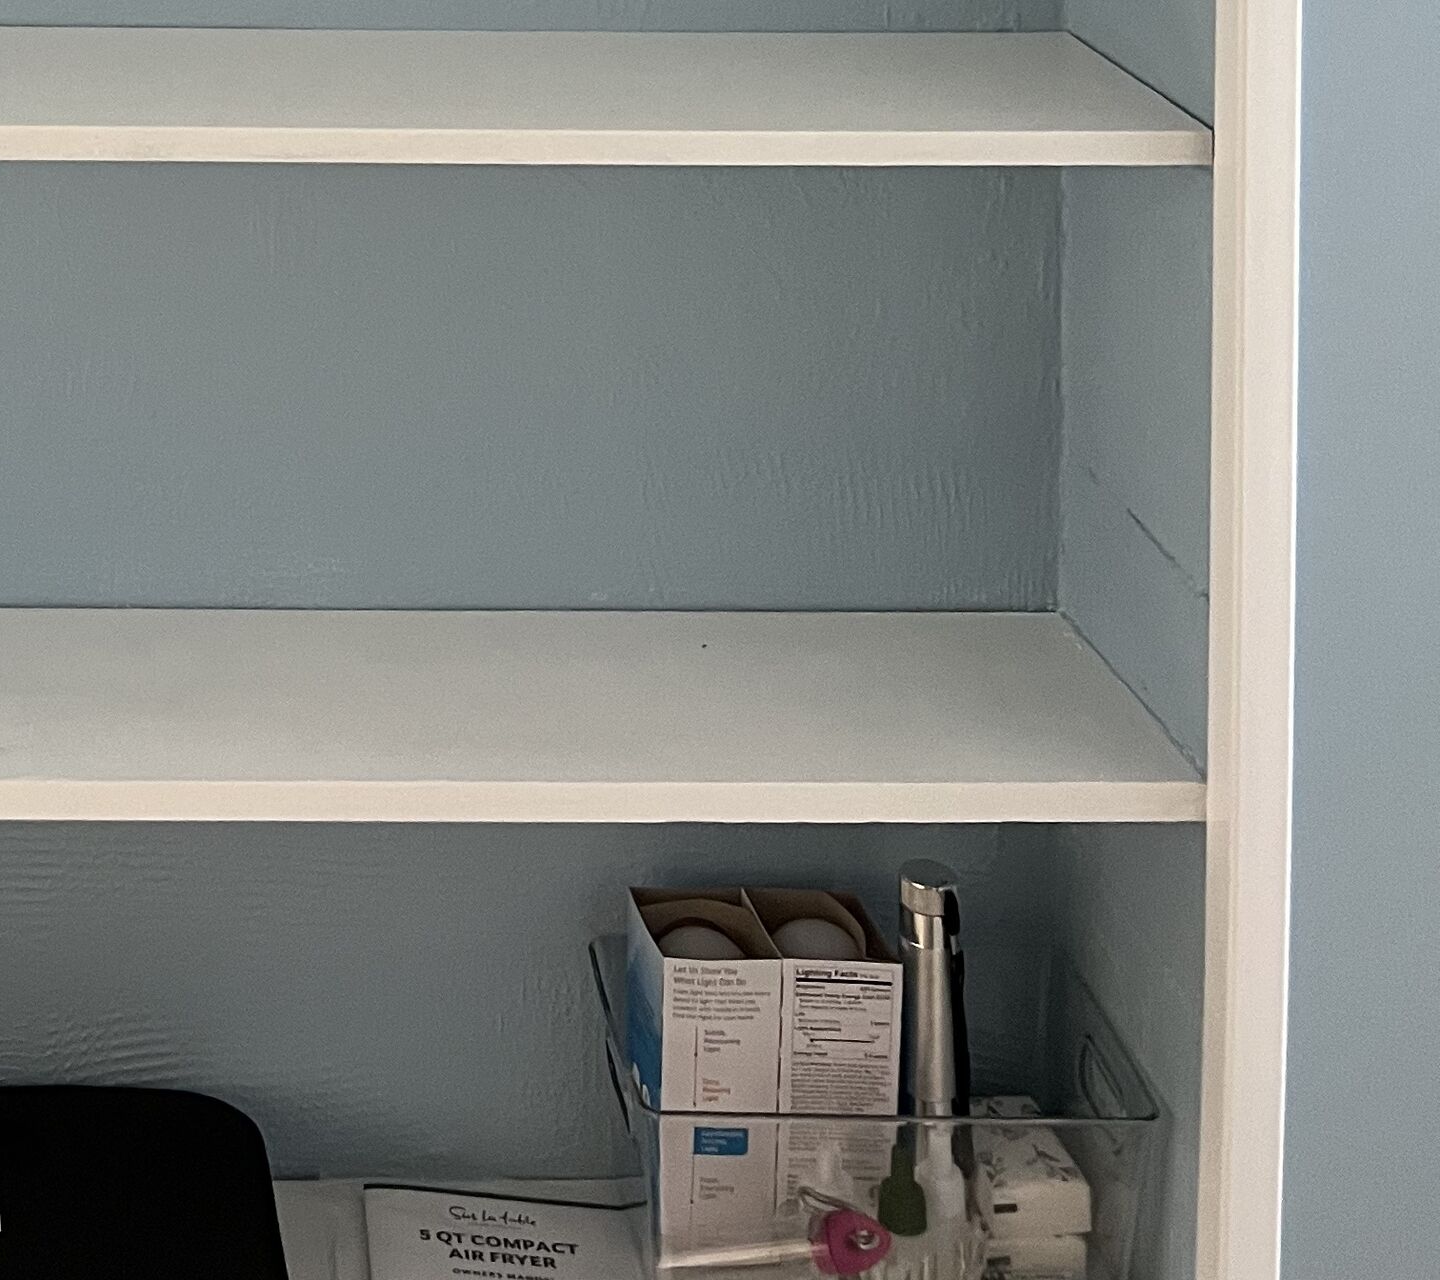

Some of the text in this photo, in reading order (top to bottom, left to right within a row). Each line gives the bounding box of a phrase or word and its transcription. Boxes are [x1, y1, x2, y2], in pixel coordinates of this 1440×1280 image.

[796, 968, 832, 978] Lighting
[419, 1229, 579, 1255] 5 QT COMPACT
[449, 1248, 557, 1269] AIR FRYER
